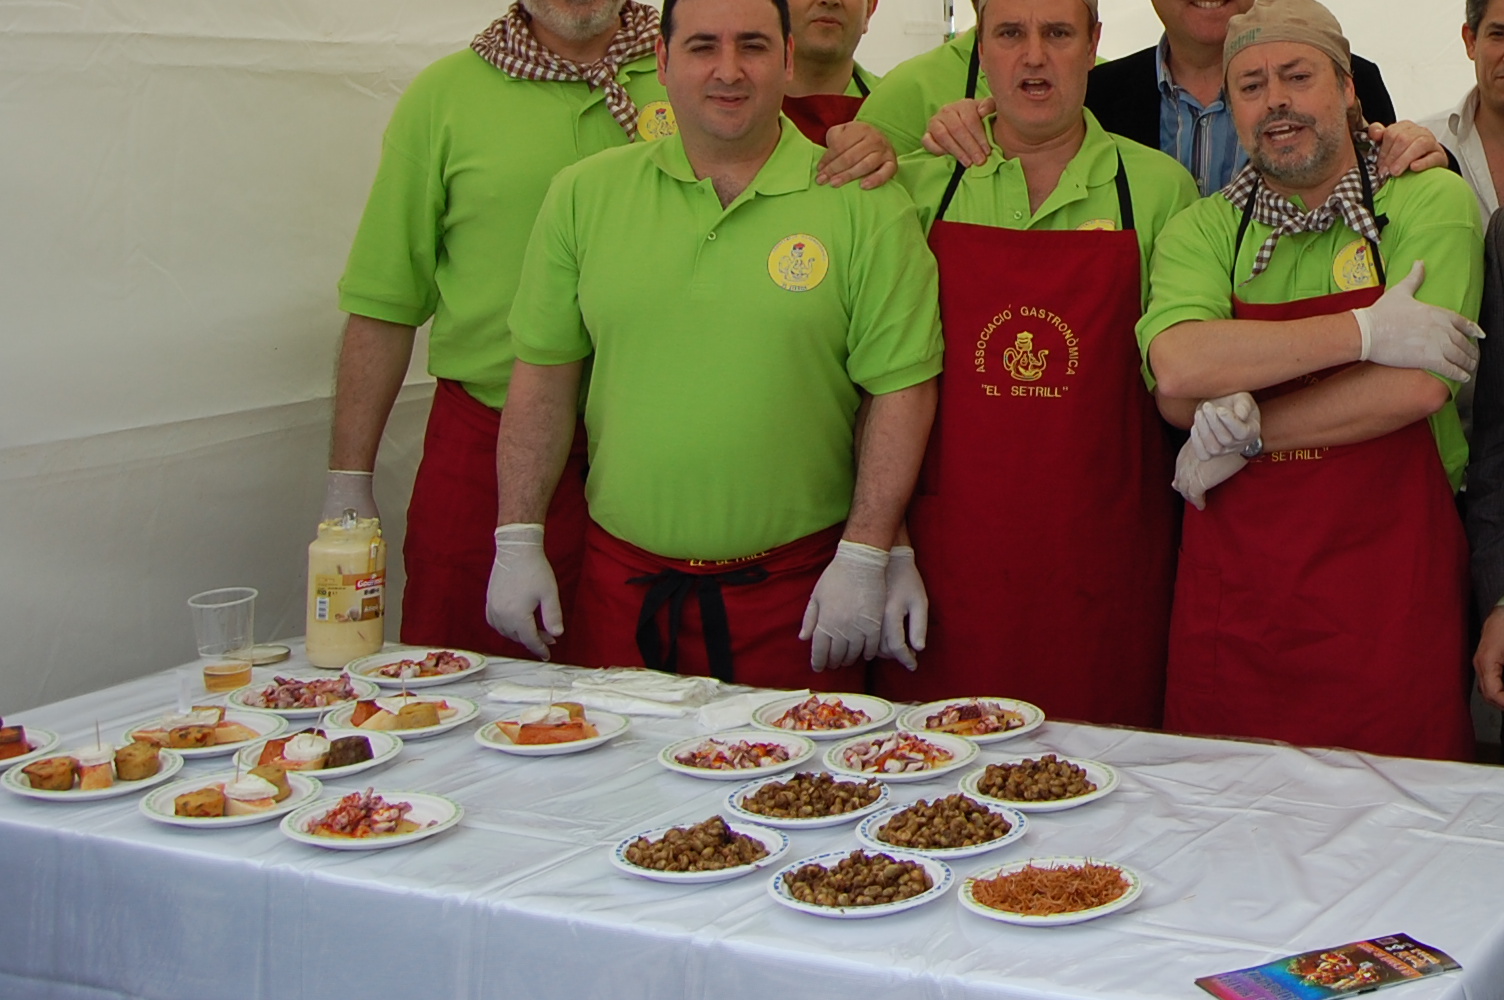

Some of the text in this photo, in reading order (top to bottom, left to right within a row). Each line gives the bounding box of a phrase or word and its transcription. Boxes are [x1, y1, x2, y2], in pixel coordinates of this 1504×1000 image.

[974, 303, 1080, 375] ASSOCIACIÓ GASTRONÒMICA
[981, 384, 1069, 398] "EL SETRILL"
